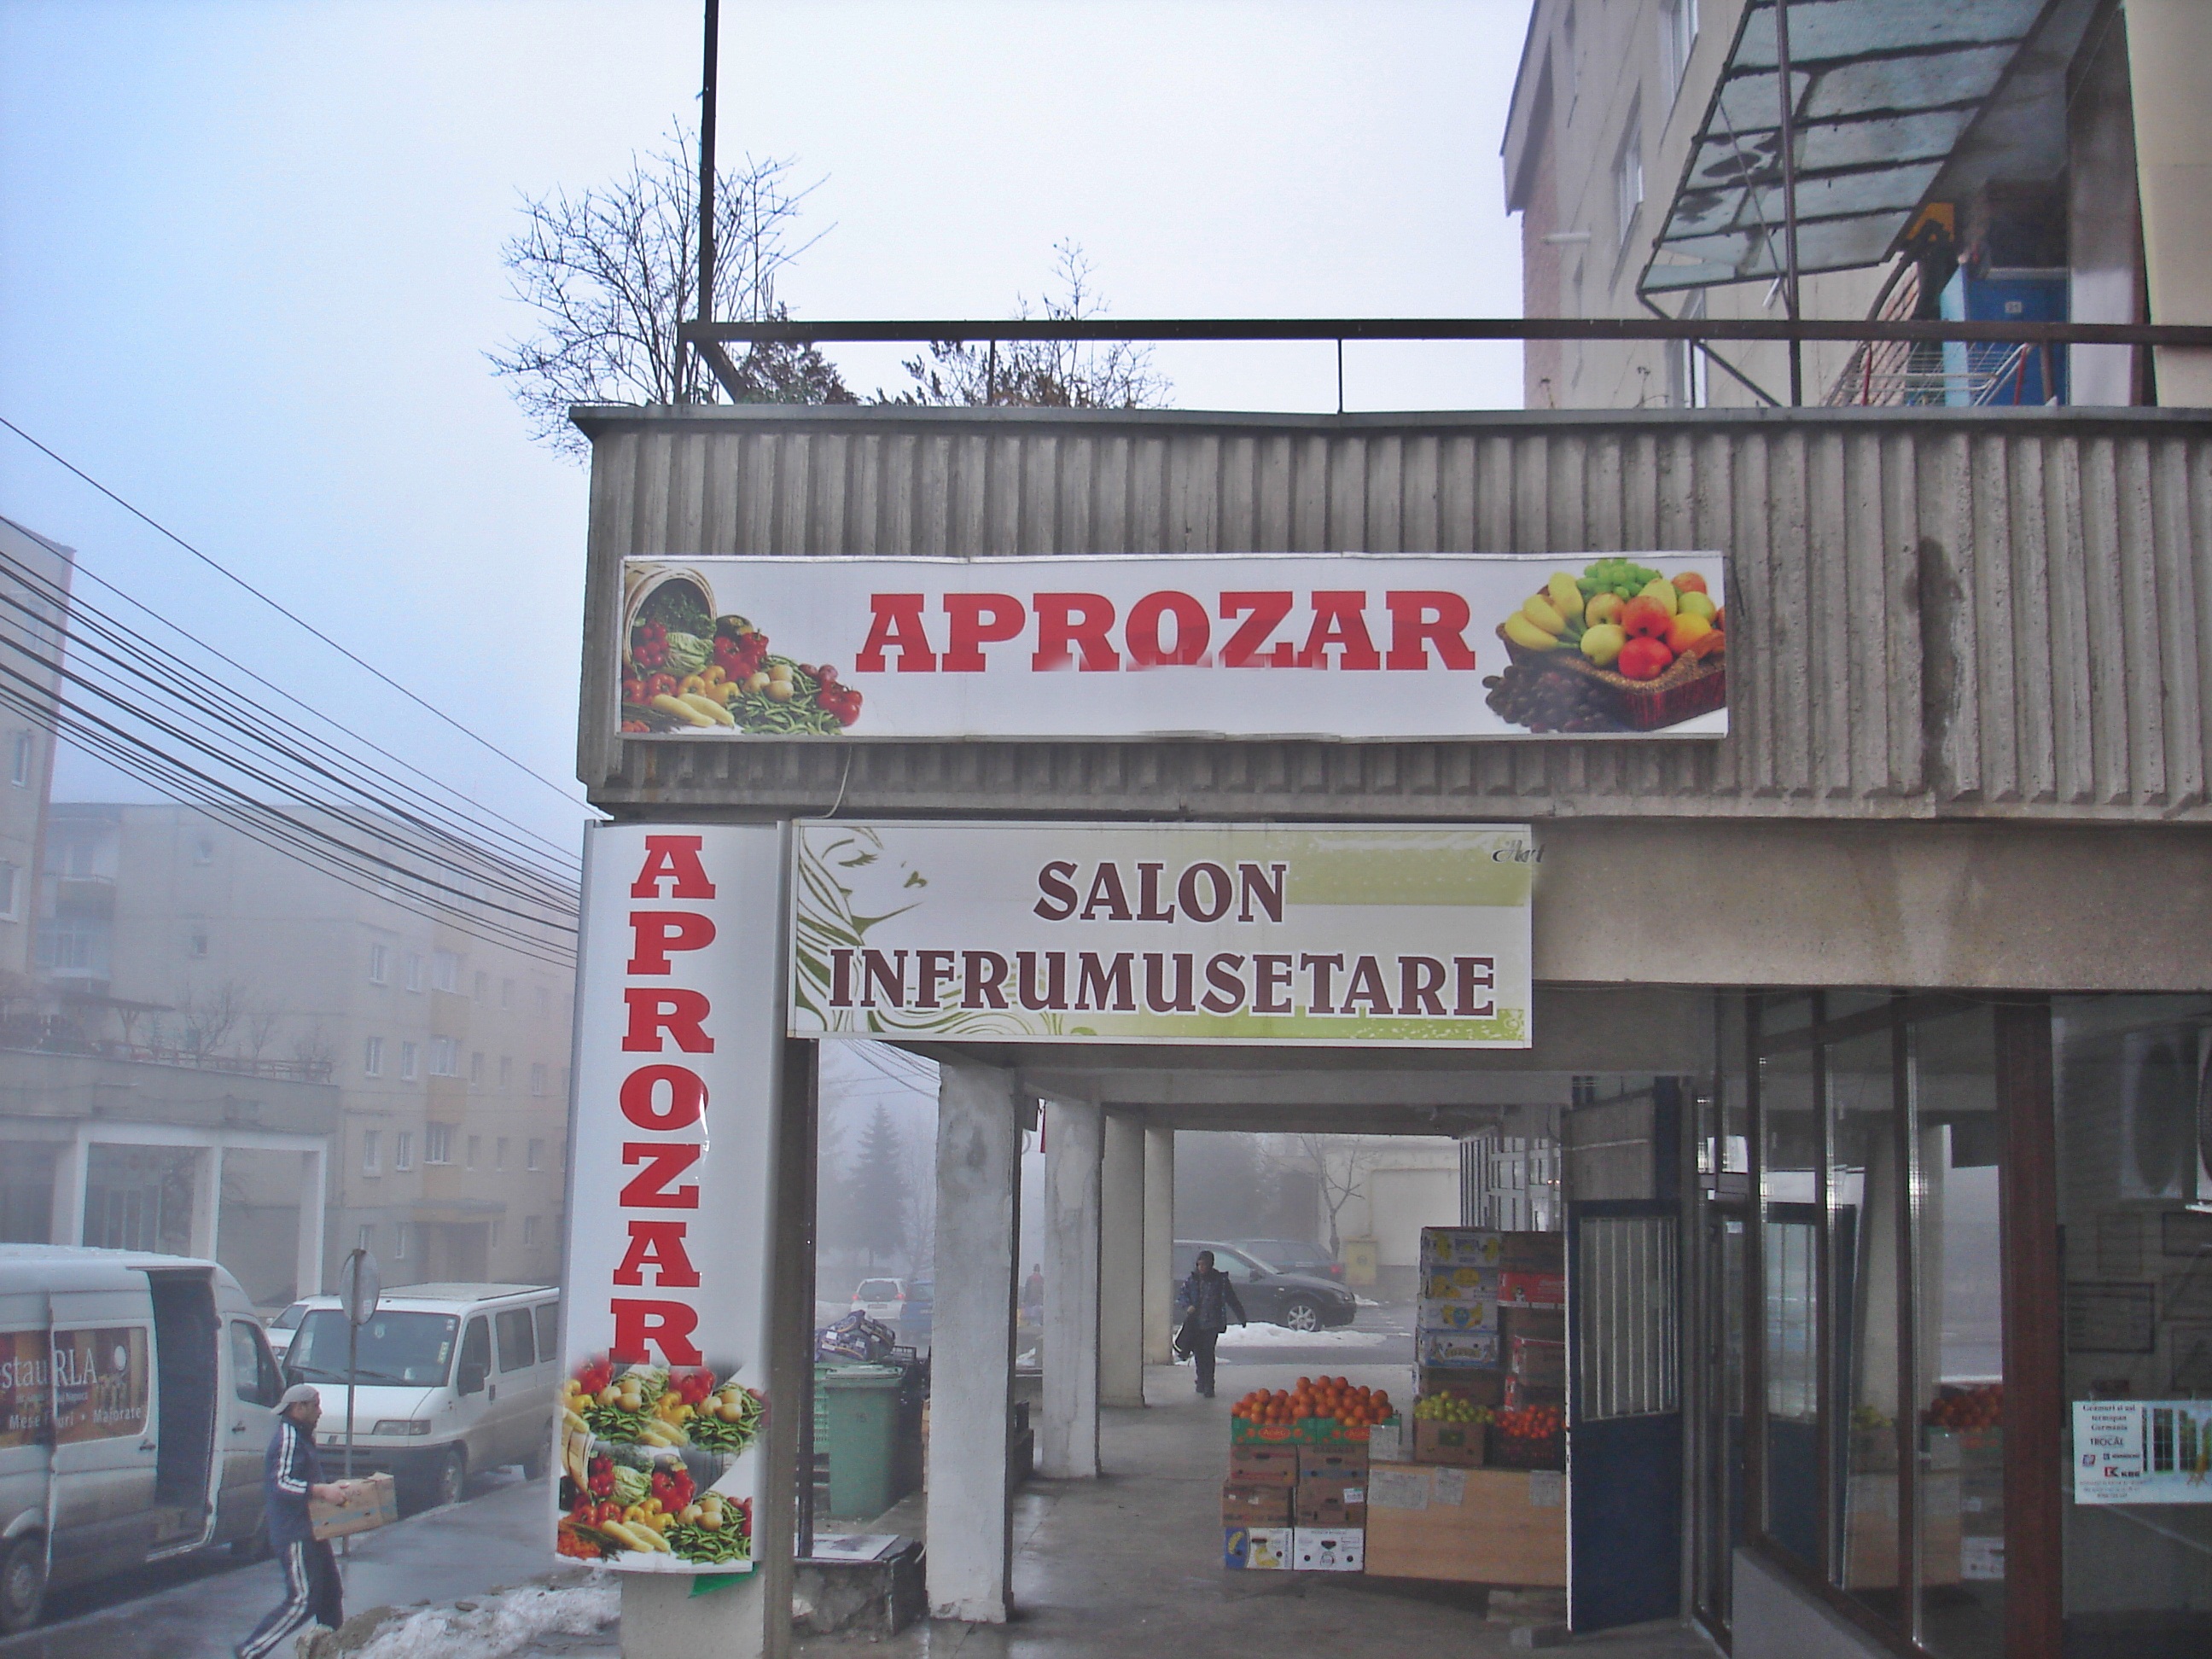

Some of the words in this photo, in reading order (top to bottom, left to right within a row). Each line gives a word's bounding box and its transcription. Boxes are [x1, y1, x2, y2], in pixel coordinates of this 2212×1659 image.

[856, 591, 1476, 672] APROZAR
[1033, 860, 1287, 924] SALON
[829, 948, 1495, 1017] INFRUMUSETARE
[608, 835, 717, 1368] APROZAR
